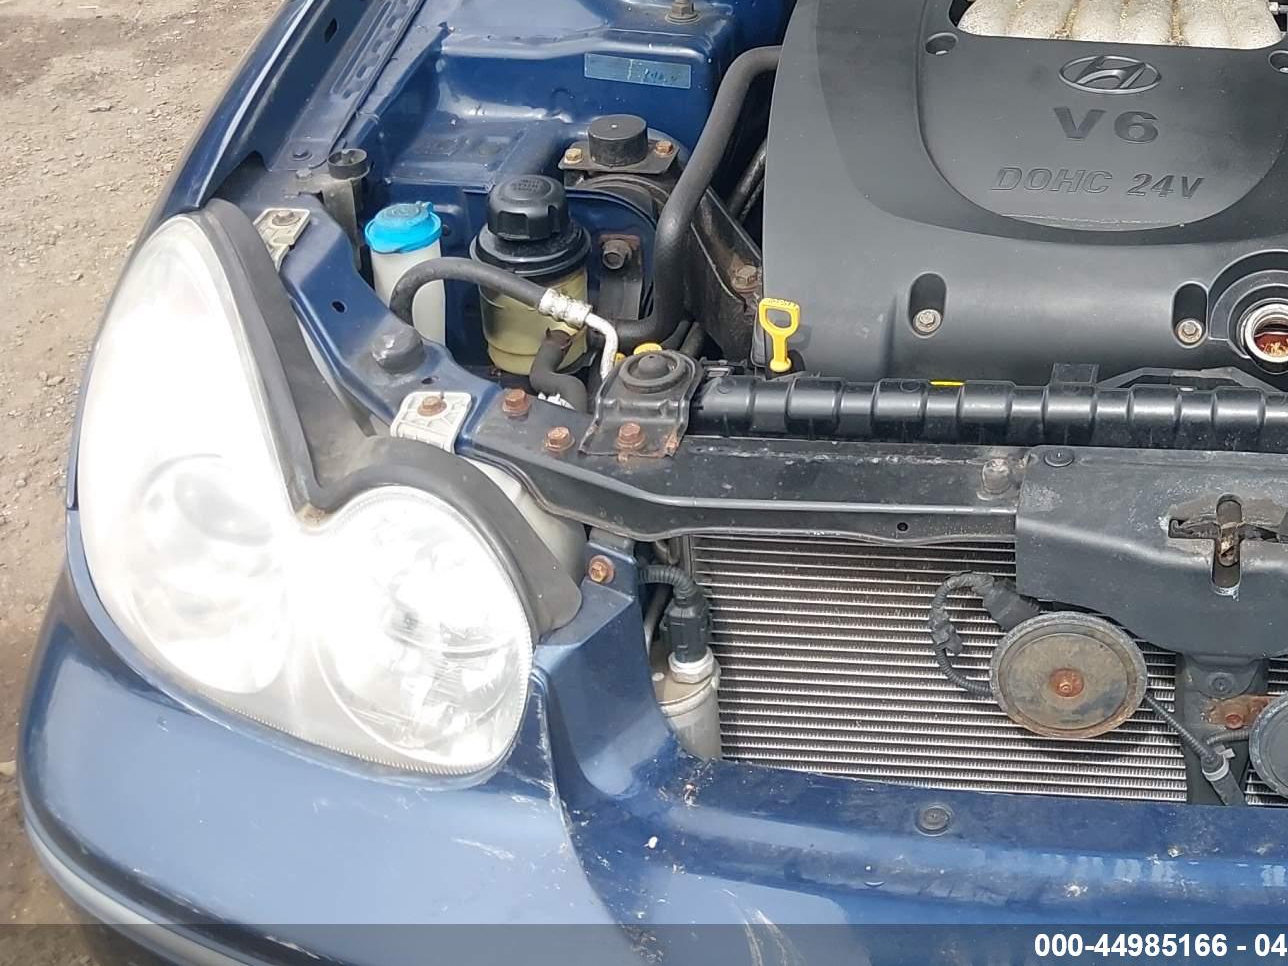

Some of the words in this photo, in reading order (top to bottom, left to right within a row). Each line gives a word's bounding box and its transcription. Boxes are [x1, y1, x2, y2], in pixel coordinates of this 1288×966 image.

[1053, 106, 1159, 144] V6
[991, 166, 1113, 194] DOHC
[1127, 172, 1206, 199] 24V
